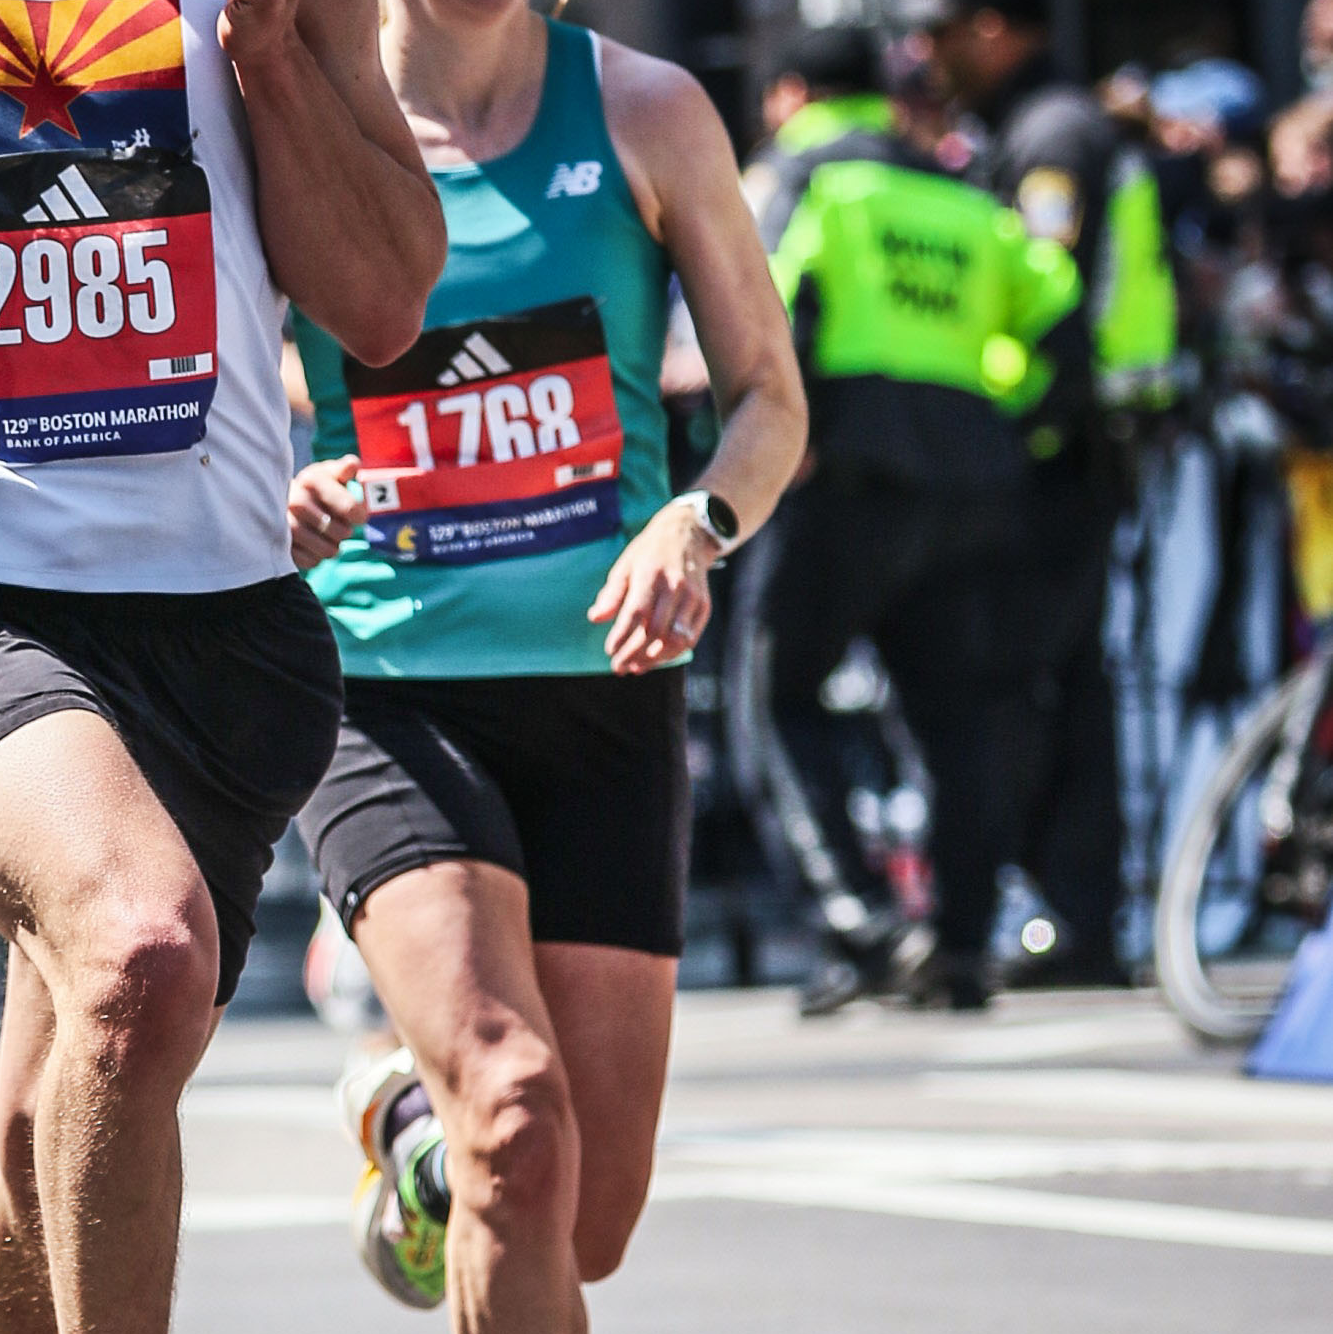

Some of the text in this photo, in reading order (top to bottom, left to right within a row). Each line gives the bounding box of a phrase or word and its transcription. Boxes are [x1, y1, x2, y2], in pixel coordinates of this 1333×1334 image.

[40, 411, 107, 432] BOSTON
[111, 401, 200, 426] MARATHON
[397, 374, 581, 471] 1768
[6, 431, 121, 448] BANK OF AMERICA
